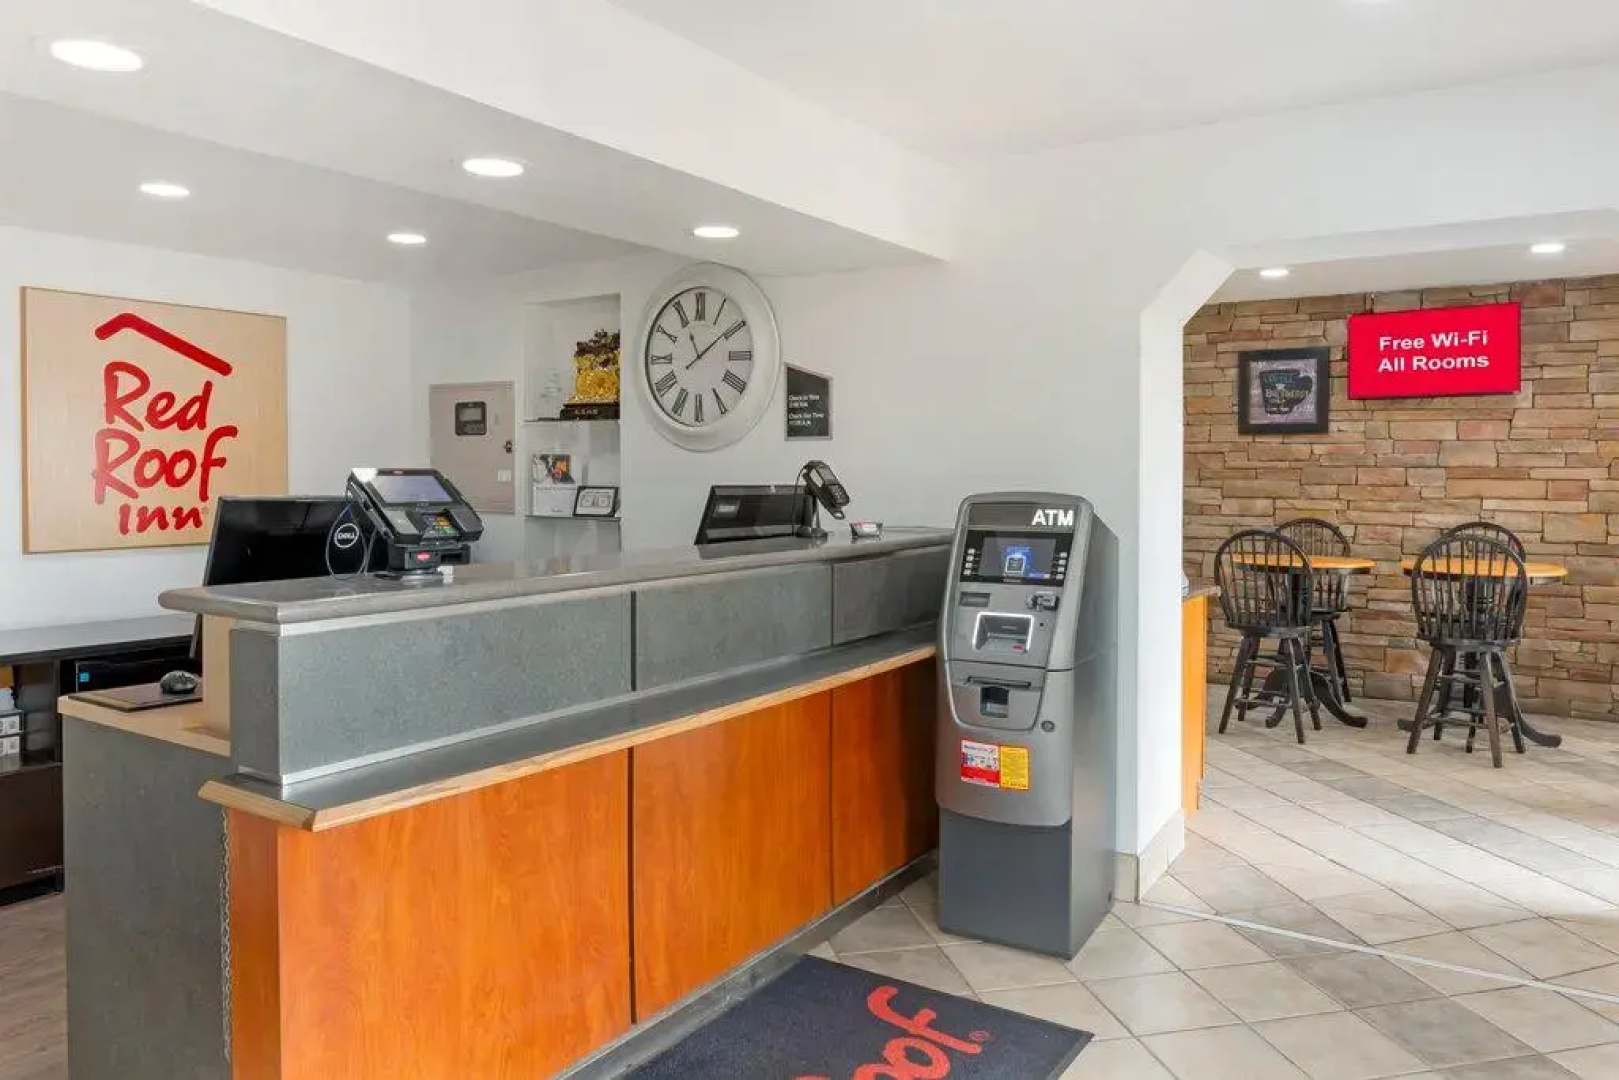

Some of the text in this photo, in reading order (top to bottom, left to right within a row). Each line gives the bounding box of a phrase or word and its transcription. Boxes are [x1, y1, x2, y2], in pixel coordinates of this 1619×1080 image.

[1378, 355, 1490, 373] All Rooms
[1379, 329, 1488, 352] Free Wi-Fi
[104, 361, 213, 432] Red
[92, 425, 238, 505] Roof
[1031, 508, 1075, 526] ATM
[792, 984, 983, 1080] of
